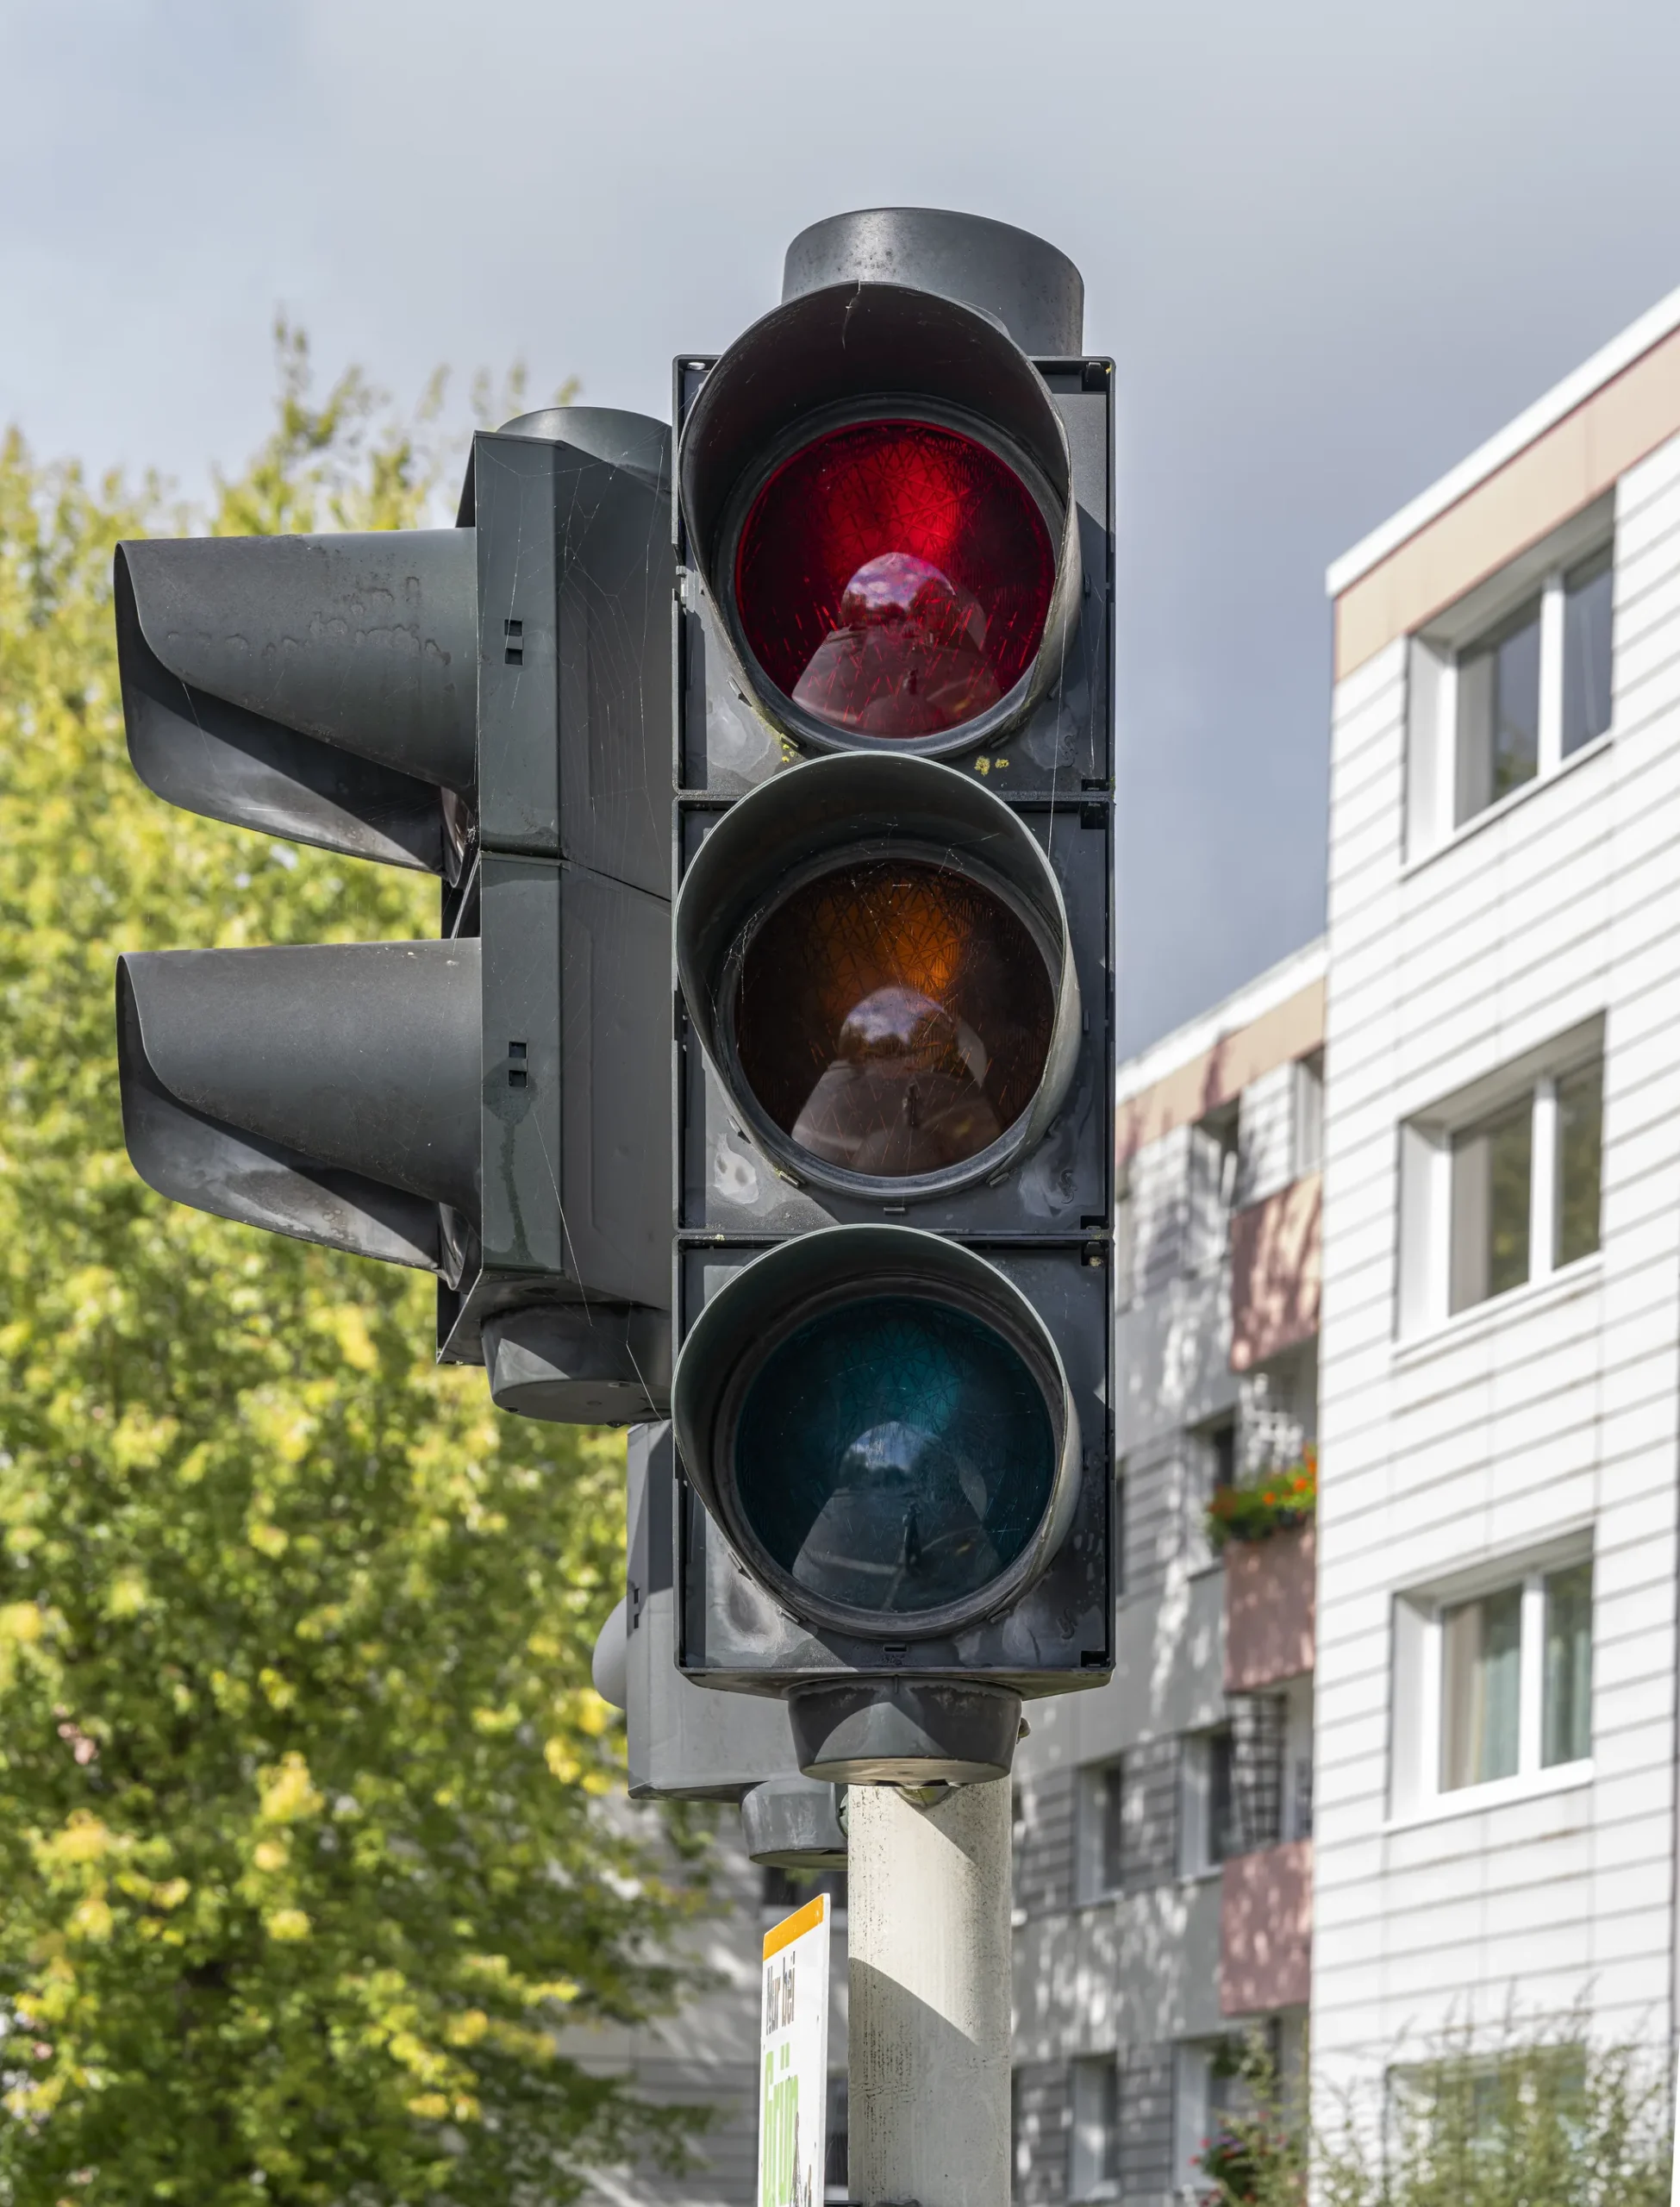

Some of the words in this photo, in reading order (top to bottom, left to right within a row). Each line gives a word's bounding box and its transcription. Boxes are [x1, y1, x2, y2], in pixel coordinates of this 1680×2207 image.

[766, 1965, 781, 2035] Nur
[782, 1950, 796, 2028] bei
[763, 2041, 799, 2207] Grün
